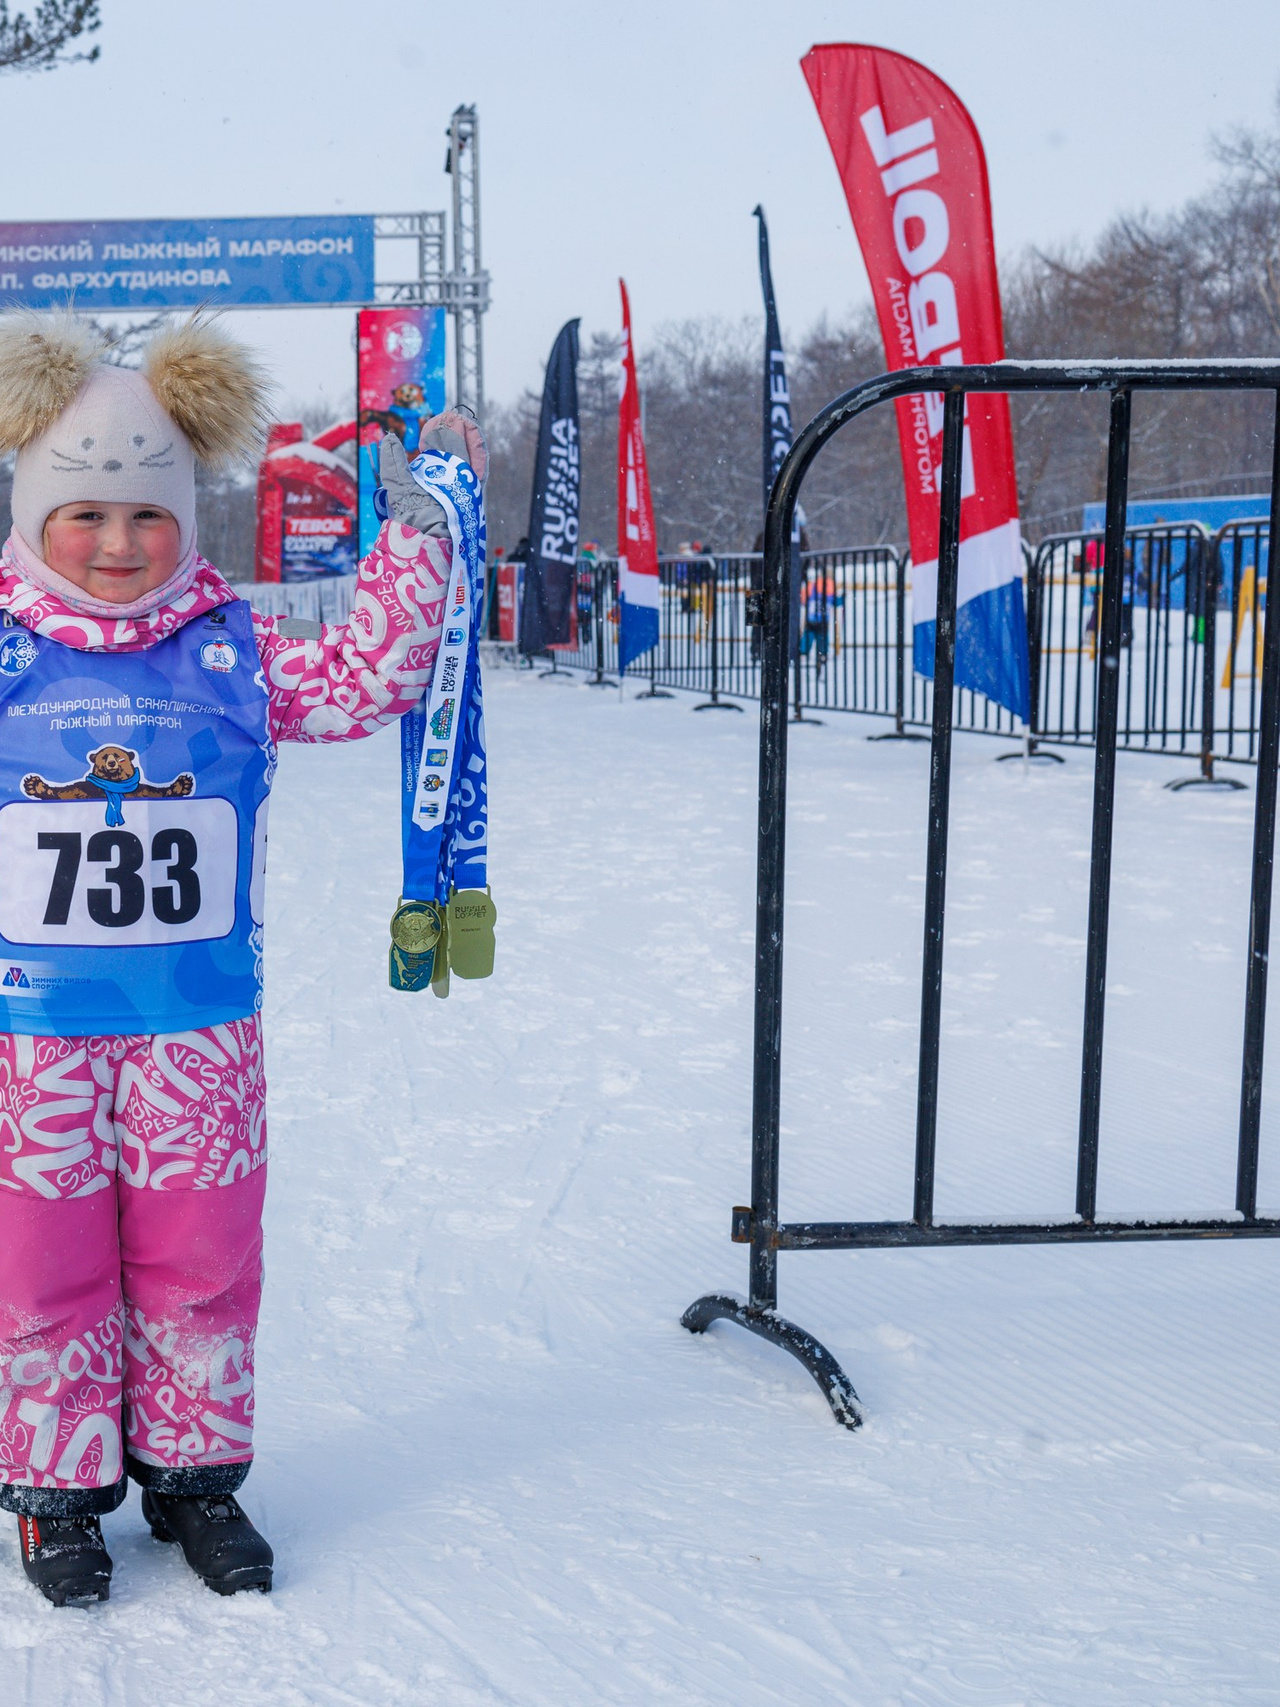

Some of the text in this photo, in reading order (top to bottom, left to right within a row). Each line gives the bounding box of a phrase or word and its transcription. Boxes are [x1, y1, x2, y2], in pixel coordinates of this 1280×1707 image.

[101, 237, 221, 262] ЛЫЖНЫЙ
[229, 237, 353, 258] МАРАФОН
[31, 268, 231, 291] ФАРХУТДИНОВА
[541, 418, 568, 561] RUSSIA
[290, 518, 347, 534] TEBOIL
[377, 571, 412, 631] VULPES
[455, 585, 465, 605] ЦСП
[440, 655, 454, 692] RUSSIA
[7, 694, 225, 717] МЕЖДУНАРОДНЫЙ САХАЛИНСКИЙ
[49, 712, 182, 731] ЛЫЖНЫЙ МАРАФОН
[37, 828, 201, 928] 733
[455, 905, 486, 913] RUSSIA
[171, 1045, 221, 1091] VPS
[125, 1114, 177, 1137] VULPES
[192, 1122, 234, 1190] VULPES
[58, 1384, 103, 1441] VULPES
[78, 1441, 102, 1479] VPS
